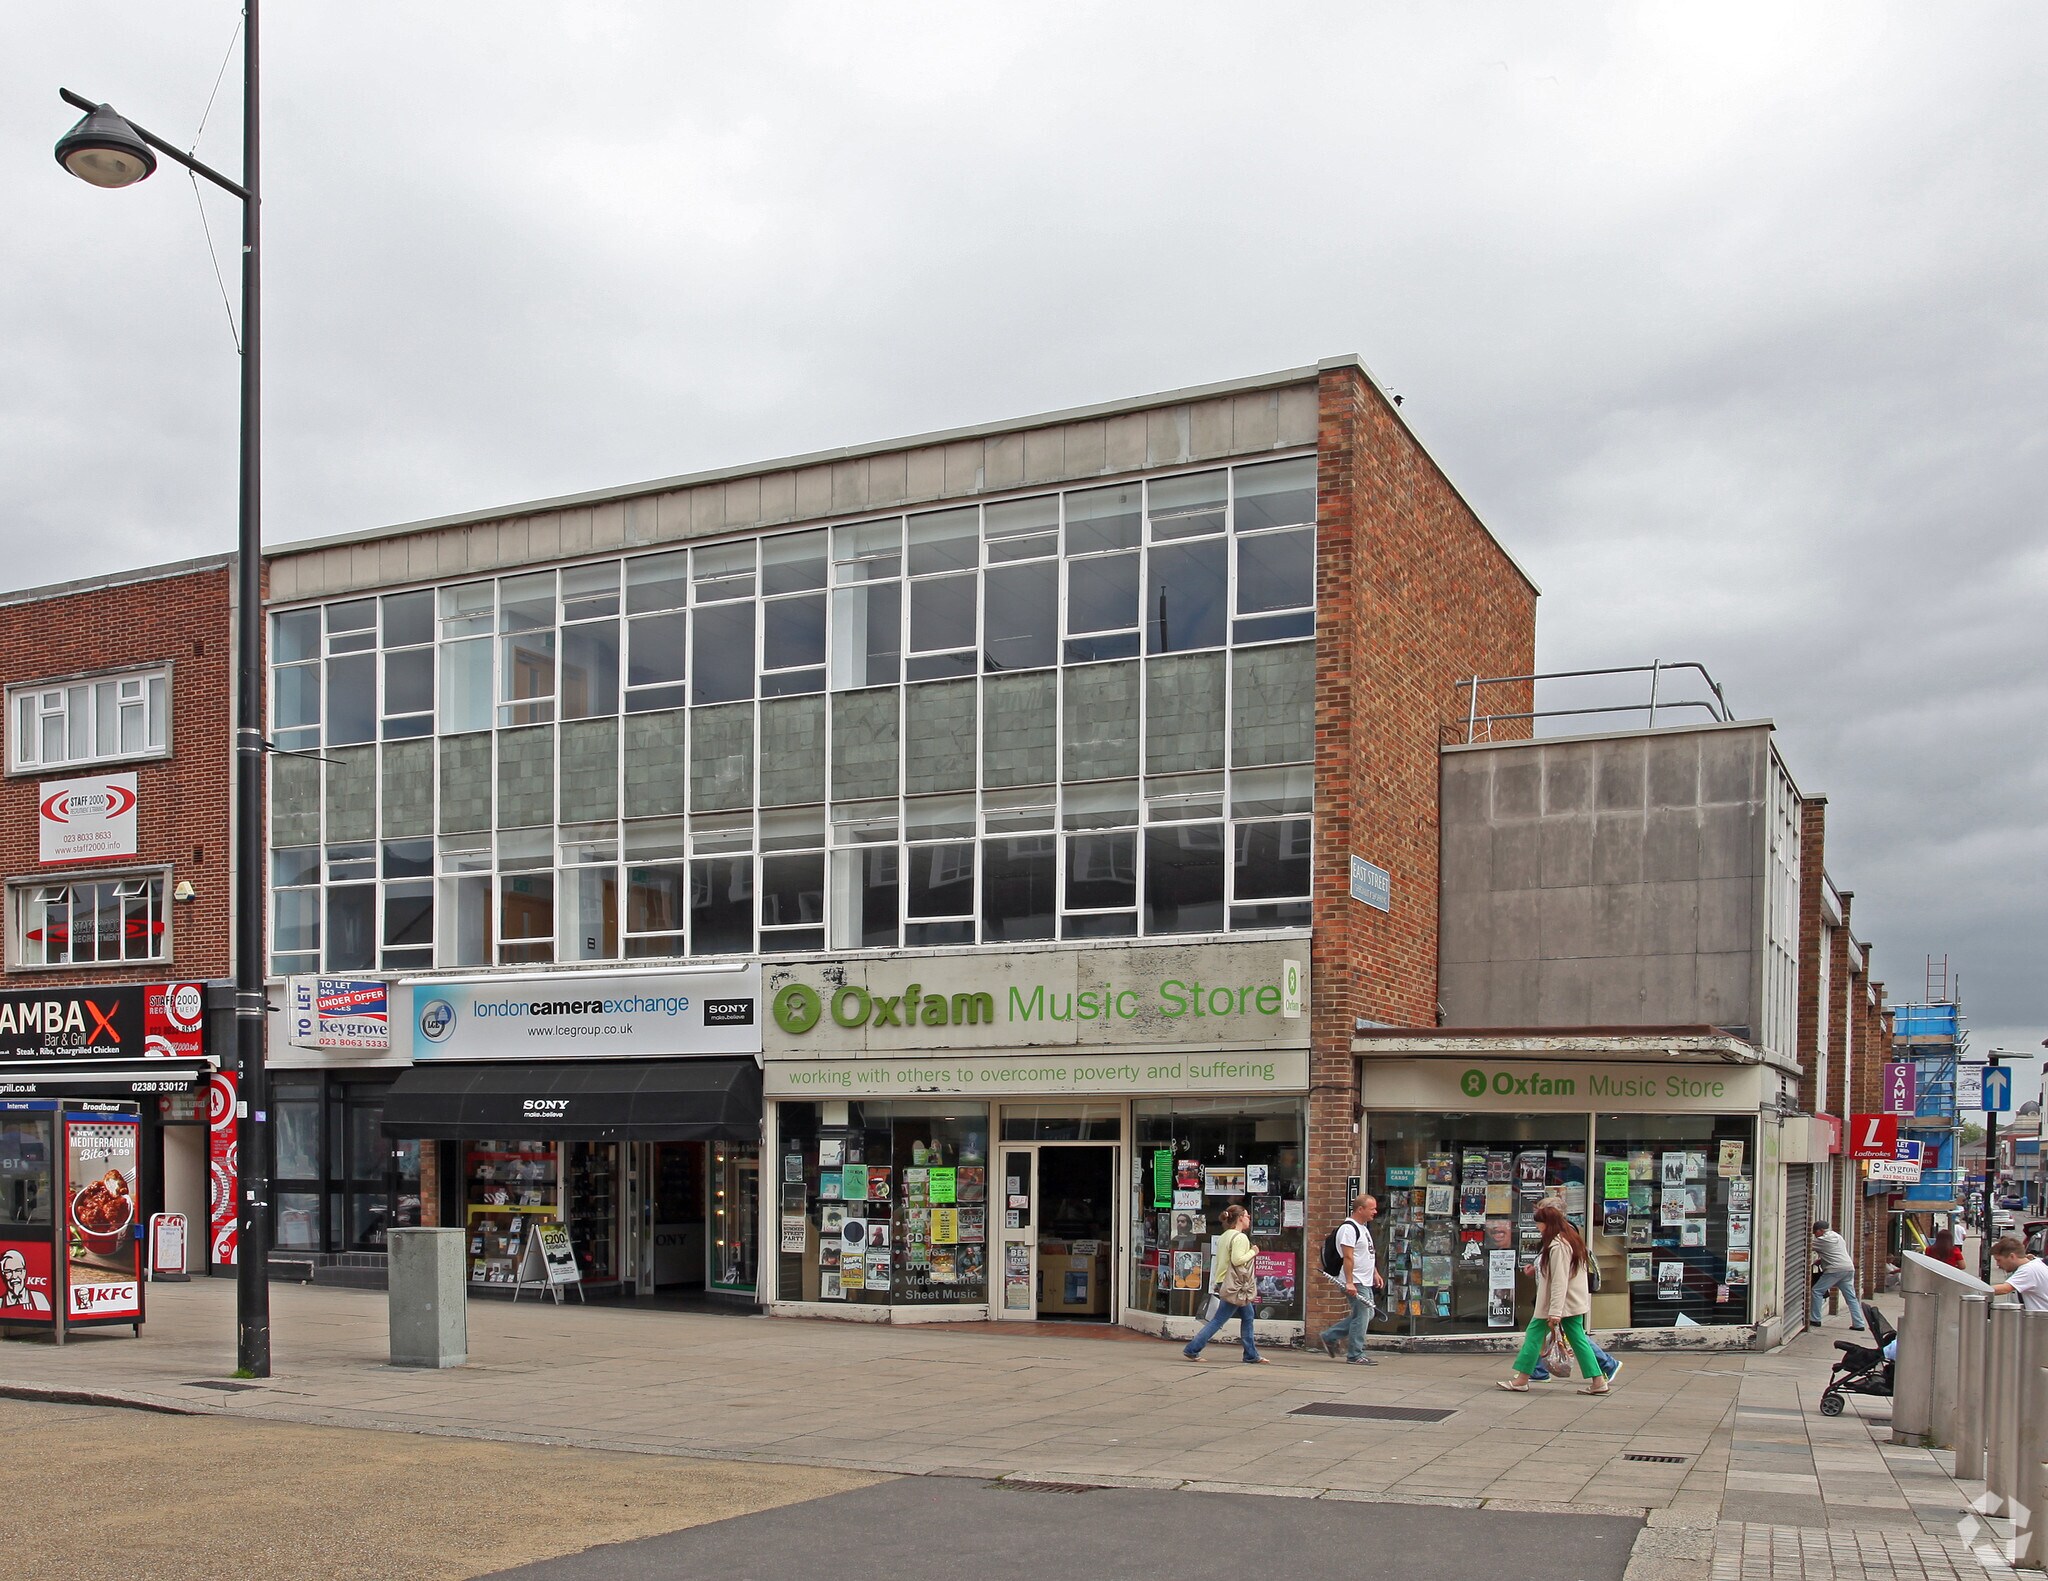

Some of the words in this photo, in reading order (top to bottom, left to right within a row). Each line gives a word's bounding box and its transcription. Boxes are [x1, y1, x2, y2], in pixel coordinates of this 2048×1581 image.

[70, 796, 88, 807] STAFF
[89, 794, 105, 806] 2000
[63, 835, 76, 843] 023
[77, 833, 94, 842] 8033
[95, 831, 112, 840] 8633
[54, 841, 121, 855] www.staff2000.info
[1353, 862, 1366, 882] EAST
[1368, 870, 1388, 892] STREET
[73, 933, 120, 943] RECRUTMENT
[150, 996, 174, 1006] STAFF
[177, 994, 198, 1005] 2000
[298, 985, 311, 1010] LET
[319, 997, 351, 1008] UNDER
[354, 990, 384, 1002] OFFER
[832, 984, 994, 1027] Oxfam
[1009, 983, 1139, 1022] Music
[1159, 979, 1281, 1018] Store
[709, 1004, 748, 1014] SONY
[298, 1018, 312, 1037] TO
[320, 1020, 388, 1037] Keygrove
[427, 1020, 440, 1029] LCE
[528, 1023, 633, 1037] www.lcegroup.co.uk
[44, 1034, 60, 1046] Bar
[61, 1034, 68, 1046] &
[70, 1032, 86, 1045] Grill
[57, 1046, 92, 1056] Chargrilled
[93, 1046, 119, 1054] Chicken
[789, 1068, 851, 1086] working
[858, 1068, 890, 1083] with
[896, 1067, 950, 1082] others
[956, 1068, 974, 1082] to
[980, 1066, 1066, 1081] overcome
[1074, 1063, 1140, 1083] poverty
[1147, 1062, 1180, 1079] and
[1188, 1060, 1275, 1081] suffering
[132, 1082, 156, 1092] 02380
[158, 1082, 188, 1092] 330121
[1492, 1073, 1575, 1096] Oxfam
[1590, 1075, 1656, 1097] Music
[1666, 1076, 1724, 1098] Store
[1894, 1066, 1906, 1110] GAME
[82, 1103, 120, 1111] Broadband
[523, 1100, 570, 1110] SONY
[1863, 1119, 1884, 1146] L
[70, 1136, 134, 1148] MEDITERRANEAN
[80, 1148, 111, 1161] Bites
[3, 1158, 20, 1169] BT
[1873, 1162, 1880, 1174] TO
[1884, 1164, 1919, 1174] Keygrove
[1734, 1183, 1749, 1191] BEZ
[545, 1233, 566, 1245] £200
[656, 1234, 687, 1246] ONY
[906, 1233, 930, 1242] CDs
[1010, 1249, 1028, 1257] BEZ
[906, 1262, 931, 1272] DVD
[27, 1277, 47, 1286] KFC
[95, 1287, 133, 1301] KFC
[906, 1290, 939, 1300] Sheet
[943, 1290, 977, 1299] Music
